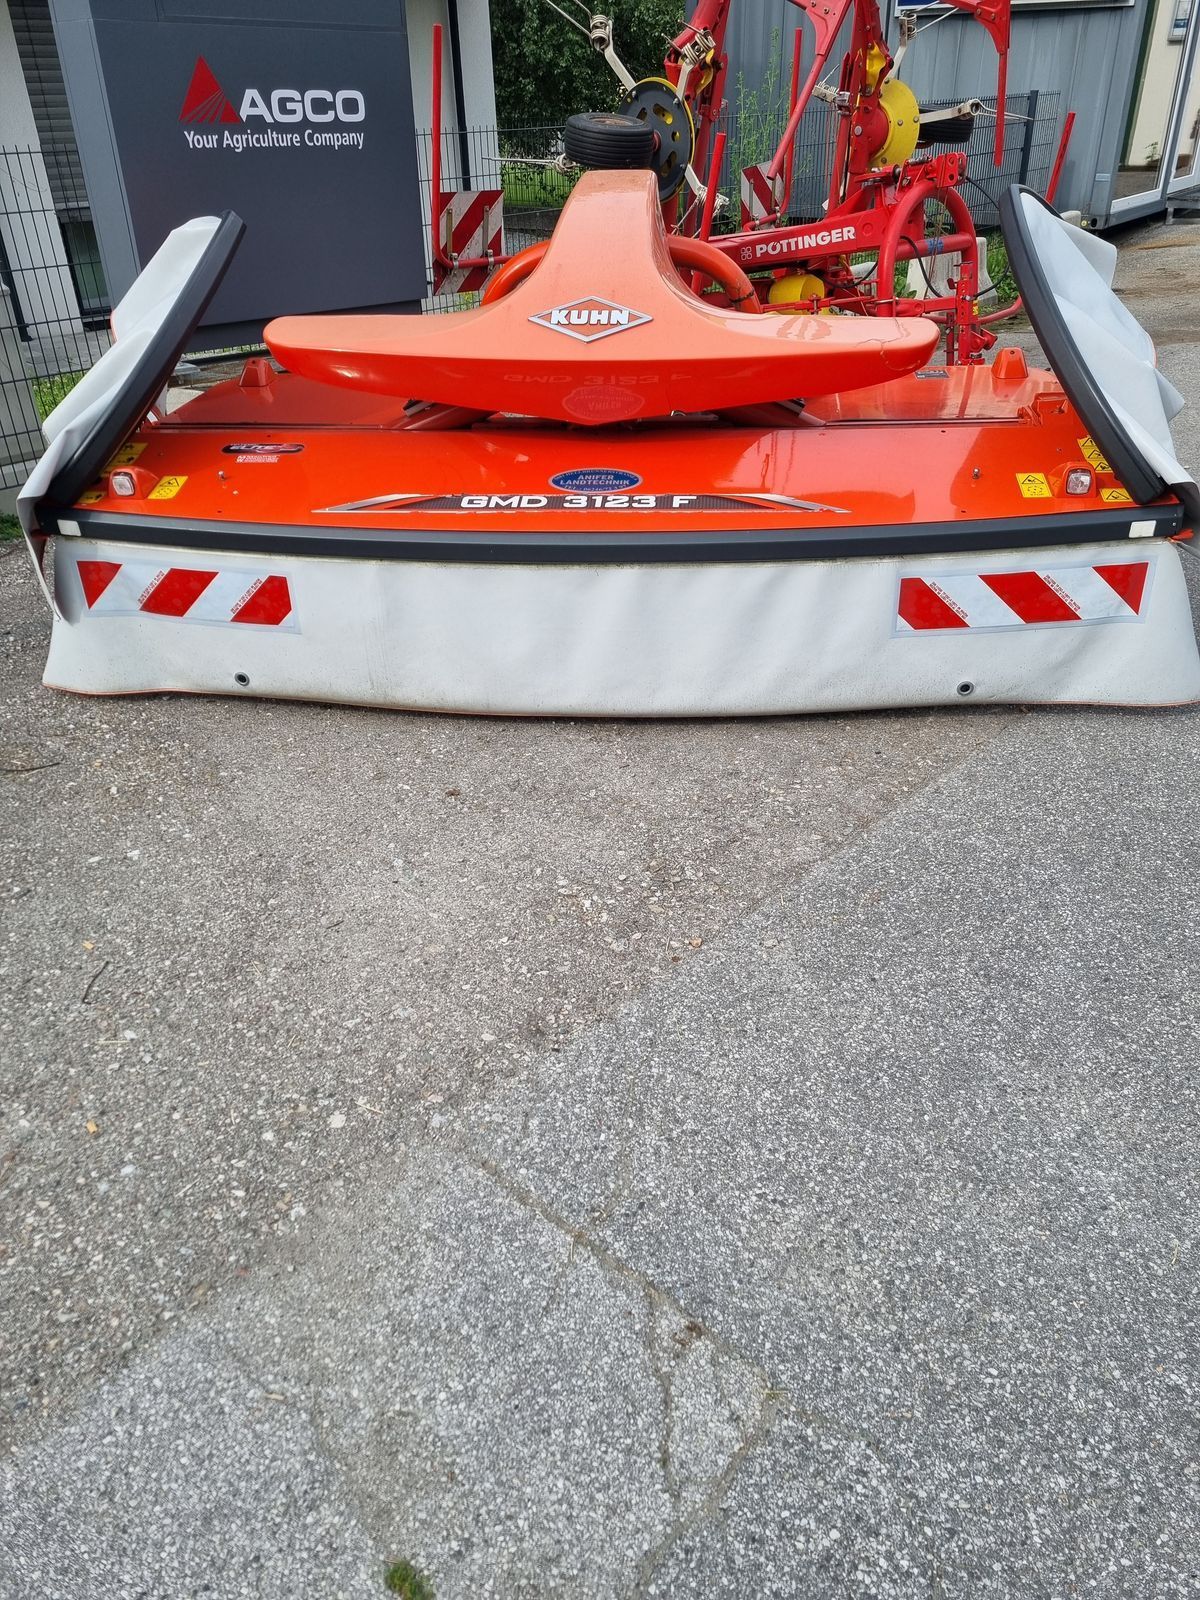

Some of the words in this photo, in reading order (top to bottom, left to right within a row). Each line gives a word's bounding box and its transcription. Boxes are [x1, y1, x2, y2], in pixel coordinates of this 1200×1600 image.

[239, 88, 366, 124] AGCO
[183, 130, 218, 149] Your
[223, 129, 301, 152] Agriculture
[304, 129, 365, 151] Company
[755, 226, 856, 258] PÖTTINGER
[550, 309, 630, 325] KUHN
[460, 495, 548, 508] GMD
[562, 495, 657, 508] 3123
[672, 495, 698, 508] F
